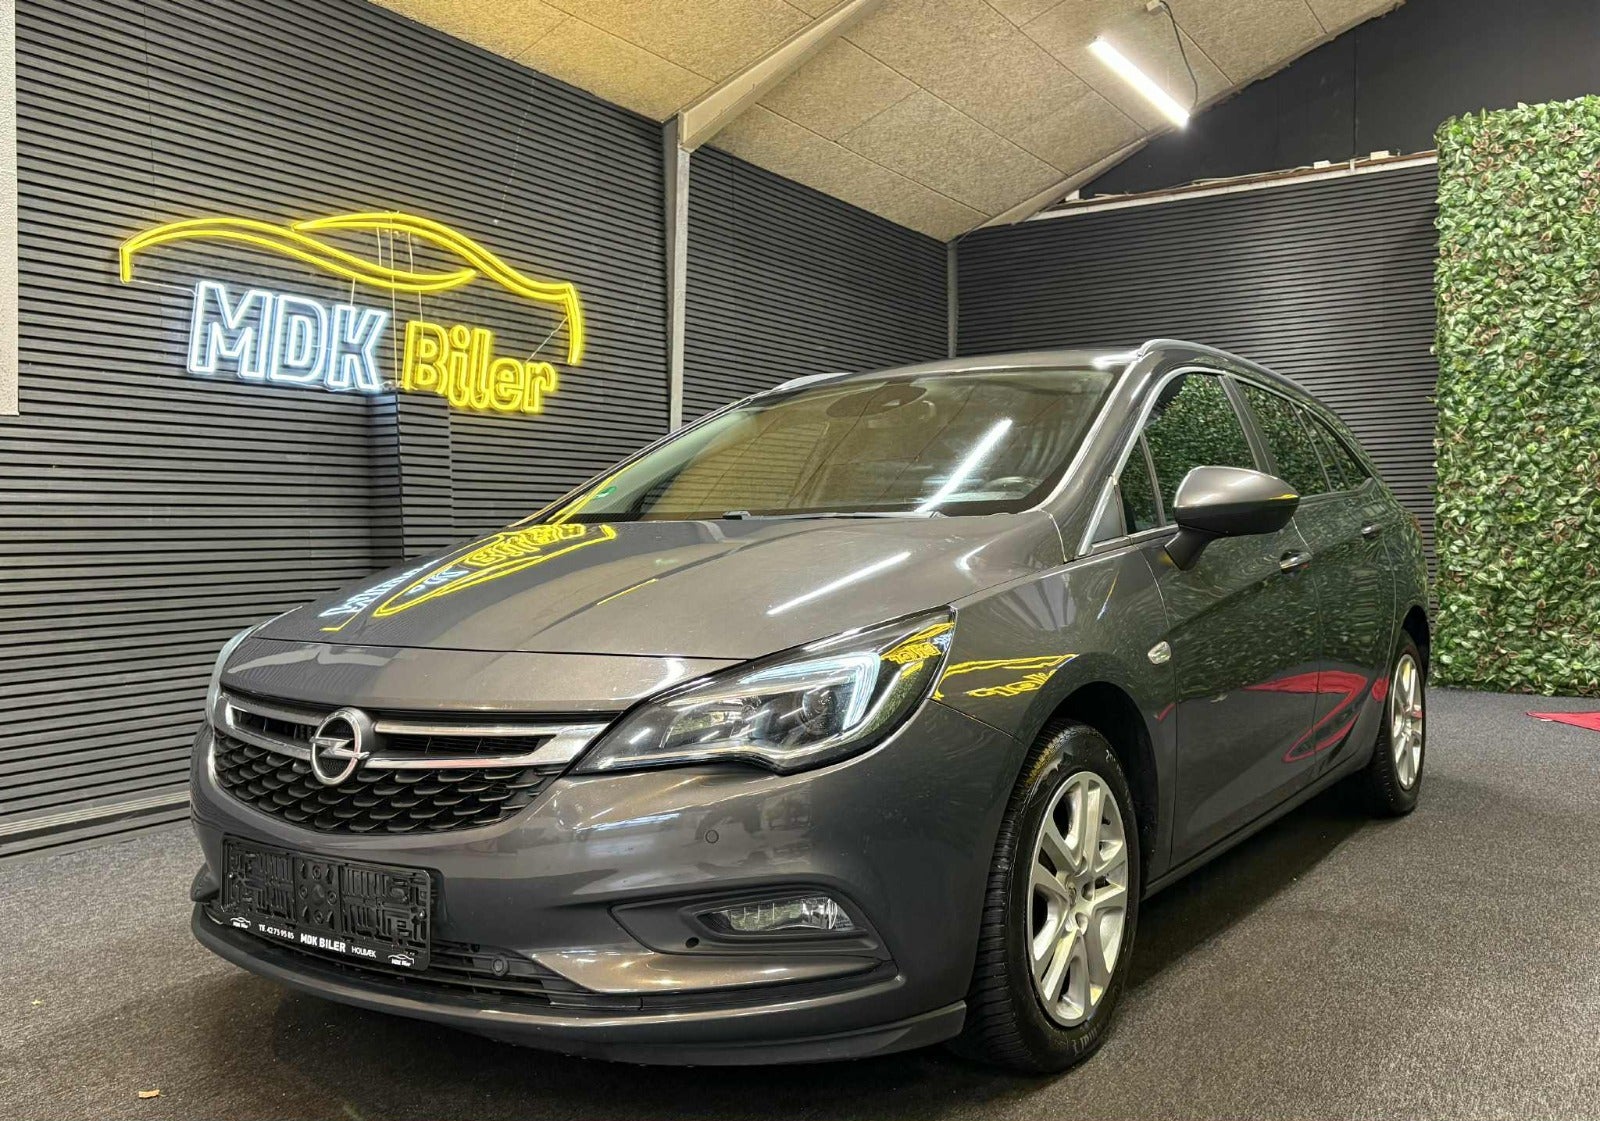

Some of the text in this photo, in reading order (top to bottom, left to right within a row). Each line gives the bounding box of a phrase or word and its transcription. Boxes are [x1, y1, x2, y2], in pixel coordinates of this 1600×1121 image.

[187, 281, 557, 413] MDK Biler
[300, 933, 317, 946] MDK
[319, 937, 346, 952] BILER
